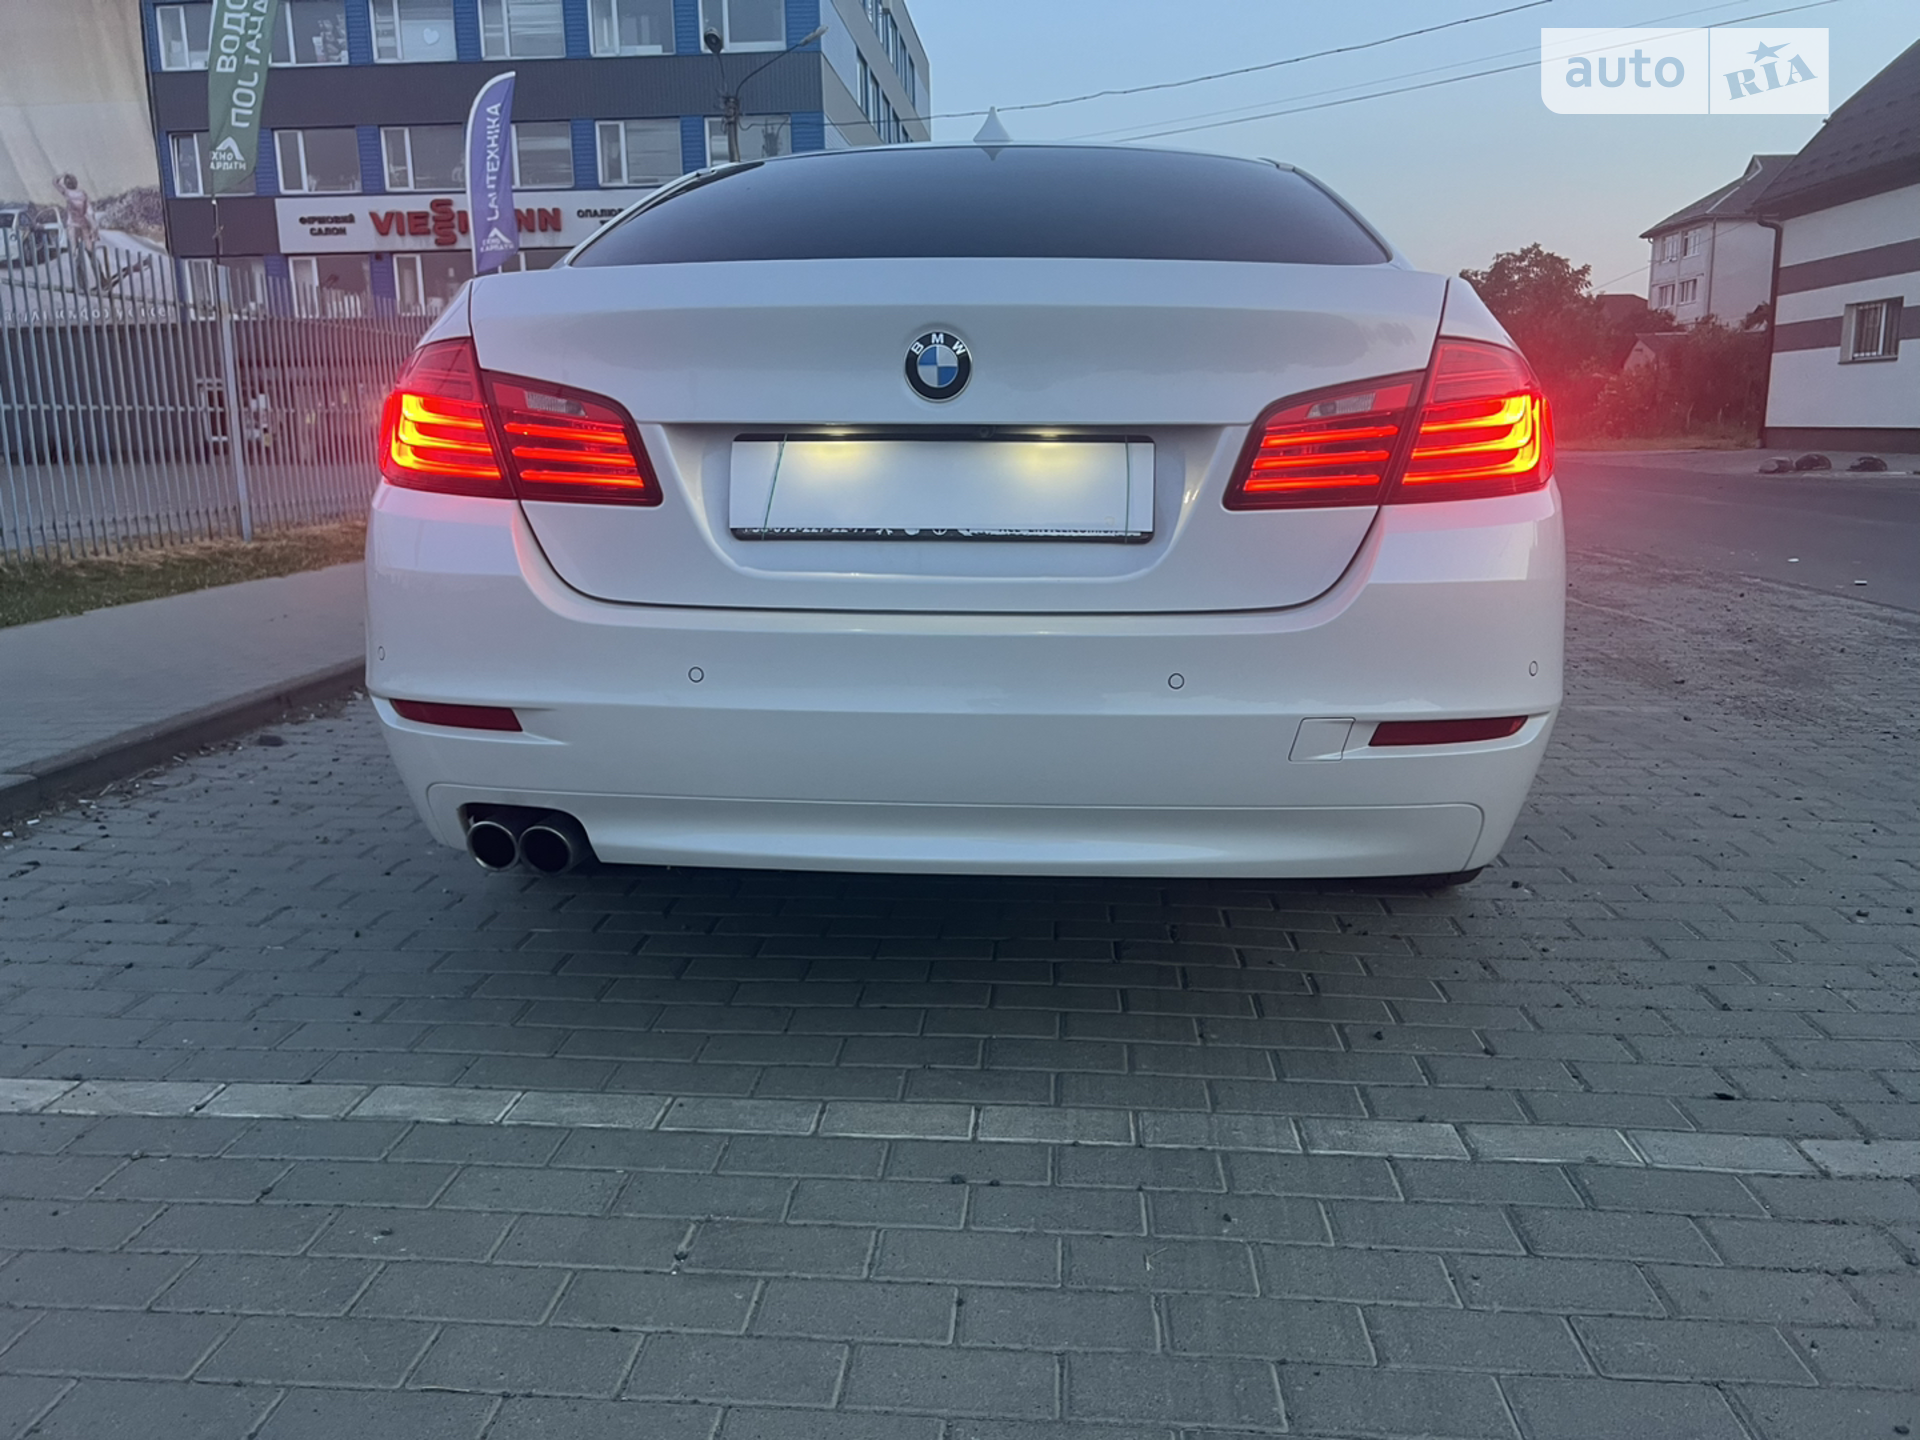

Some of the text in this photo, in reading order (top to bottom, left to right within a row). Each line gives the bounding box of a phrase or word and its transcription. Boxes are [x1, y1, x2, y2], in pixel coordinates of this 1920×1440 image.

[309, 227, 347, 237] САЛОН
[369, 199, 562, 247] VIESSNN
[911, 333, 966, 355] BMW
